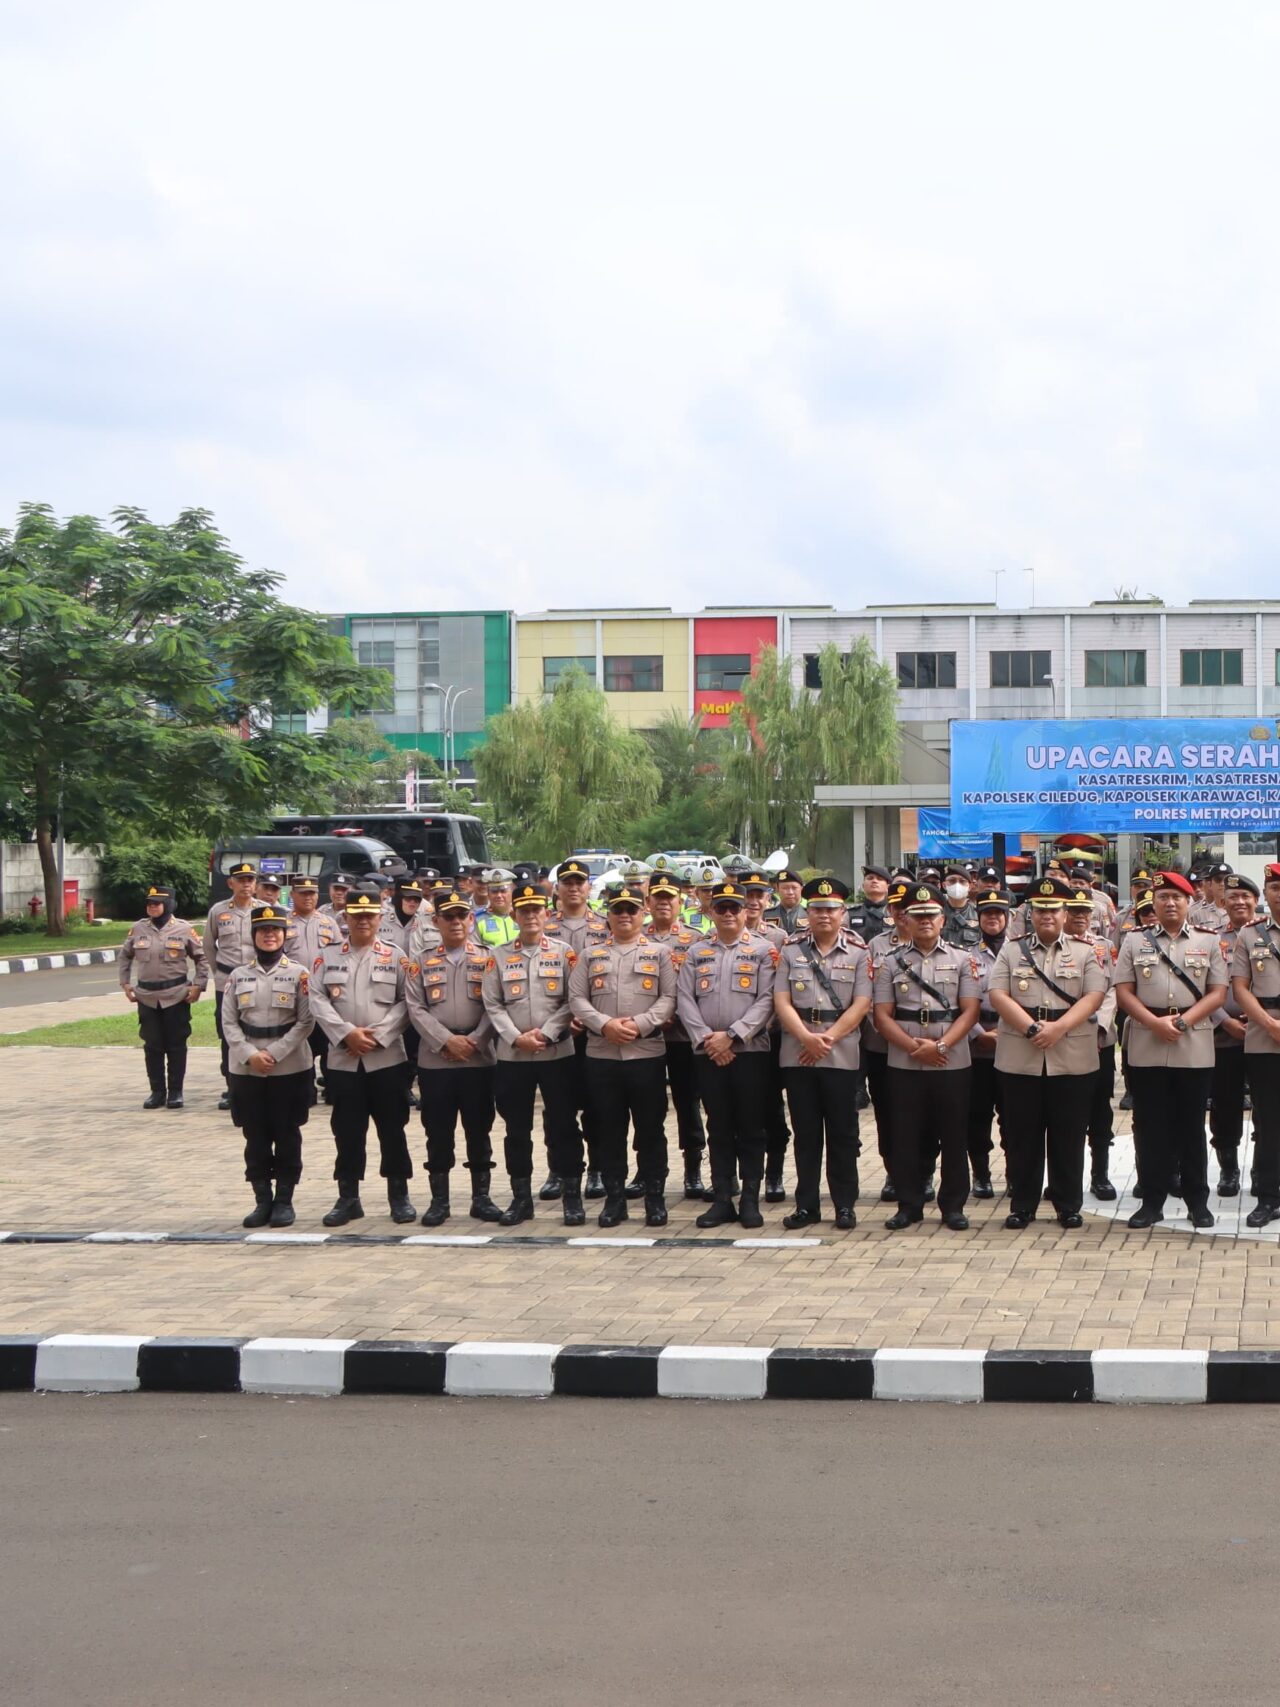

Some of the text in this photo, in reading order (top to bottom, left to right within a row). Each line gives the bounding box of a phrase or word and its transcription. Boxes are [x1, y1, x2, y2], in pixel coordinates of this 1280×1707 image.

[1026, 745, 1175, 769] UPACARA
[1181, 744, 1280, 768] SERAH
[1078, 774, 1191, 788] KASATRESKRIM,
[963, 791, 1035, 804] KAPOLSEK
[1038, 791, 1101, 806] CILEDUG,
[1105, 790, 1177, 803] KAPOLSEK
[1180, 790, 1264, 805] KARAWACI,
[1135, 808, 1187, 820] POLRES
[374, 965, 396, 974] POLRI
